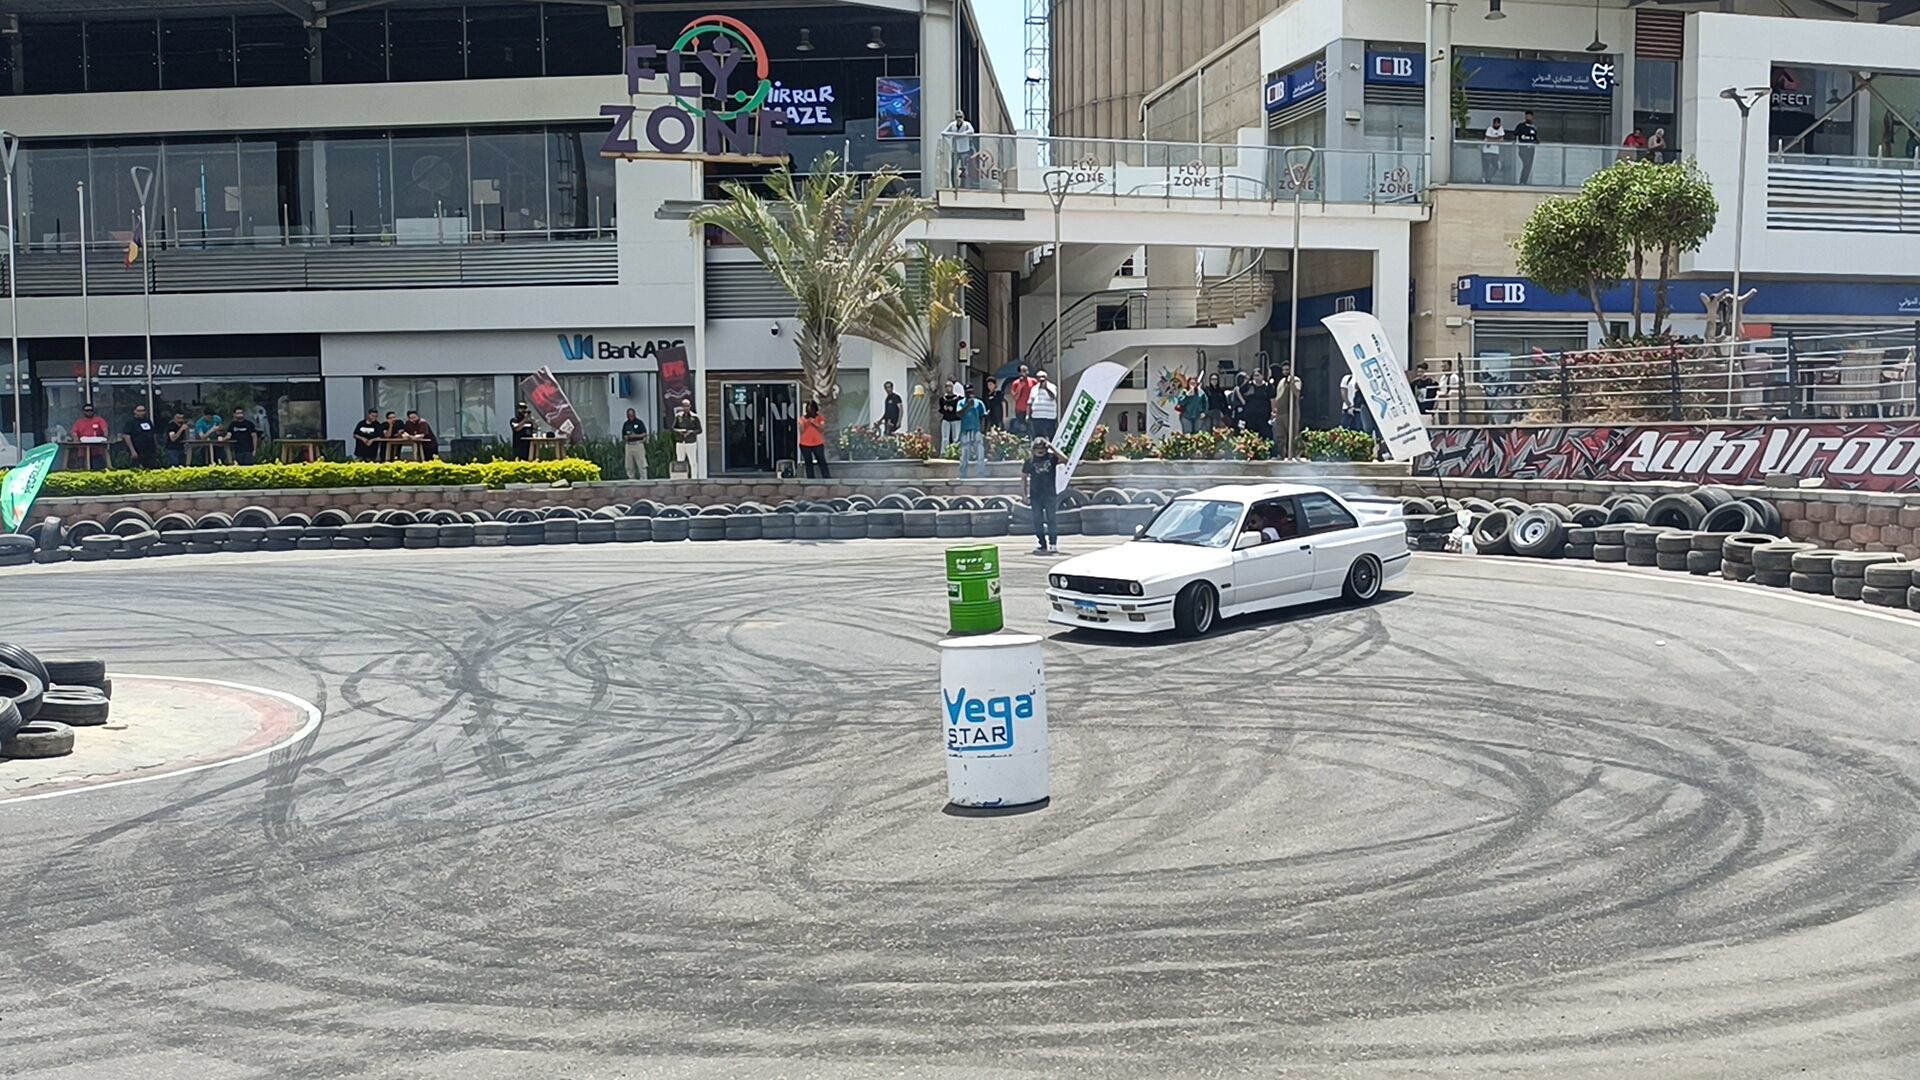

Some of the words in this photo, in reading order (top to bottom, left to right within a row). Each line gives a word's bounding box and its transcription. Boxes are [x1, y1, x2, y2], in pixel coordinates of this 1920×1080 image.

[628, 45, 745, 102] FLY
[1376, 57, 1412, 76] CIB
[600, 105, 789, 156] ZONE
[1174, 177, 1211, 187] ZONE
[1384, 171, 1405, 182] FLY
[1379, 183, 1414, 193] ZONE
[1486, 283, 1526, 303] CIB
[943, 687, 1034, 748] Vega
[948, 726, 1007, 744] STAR
